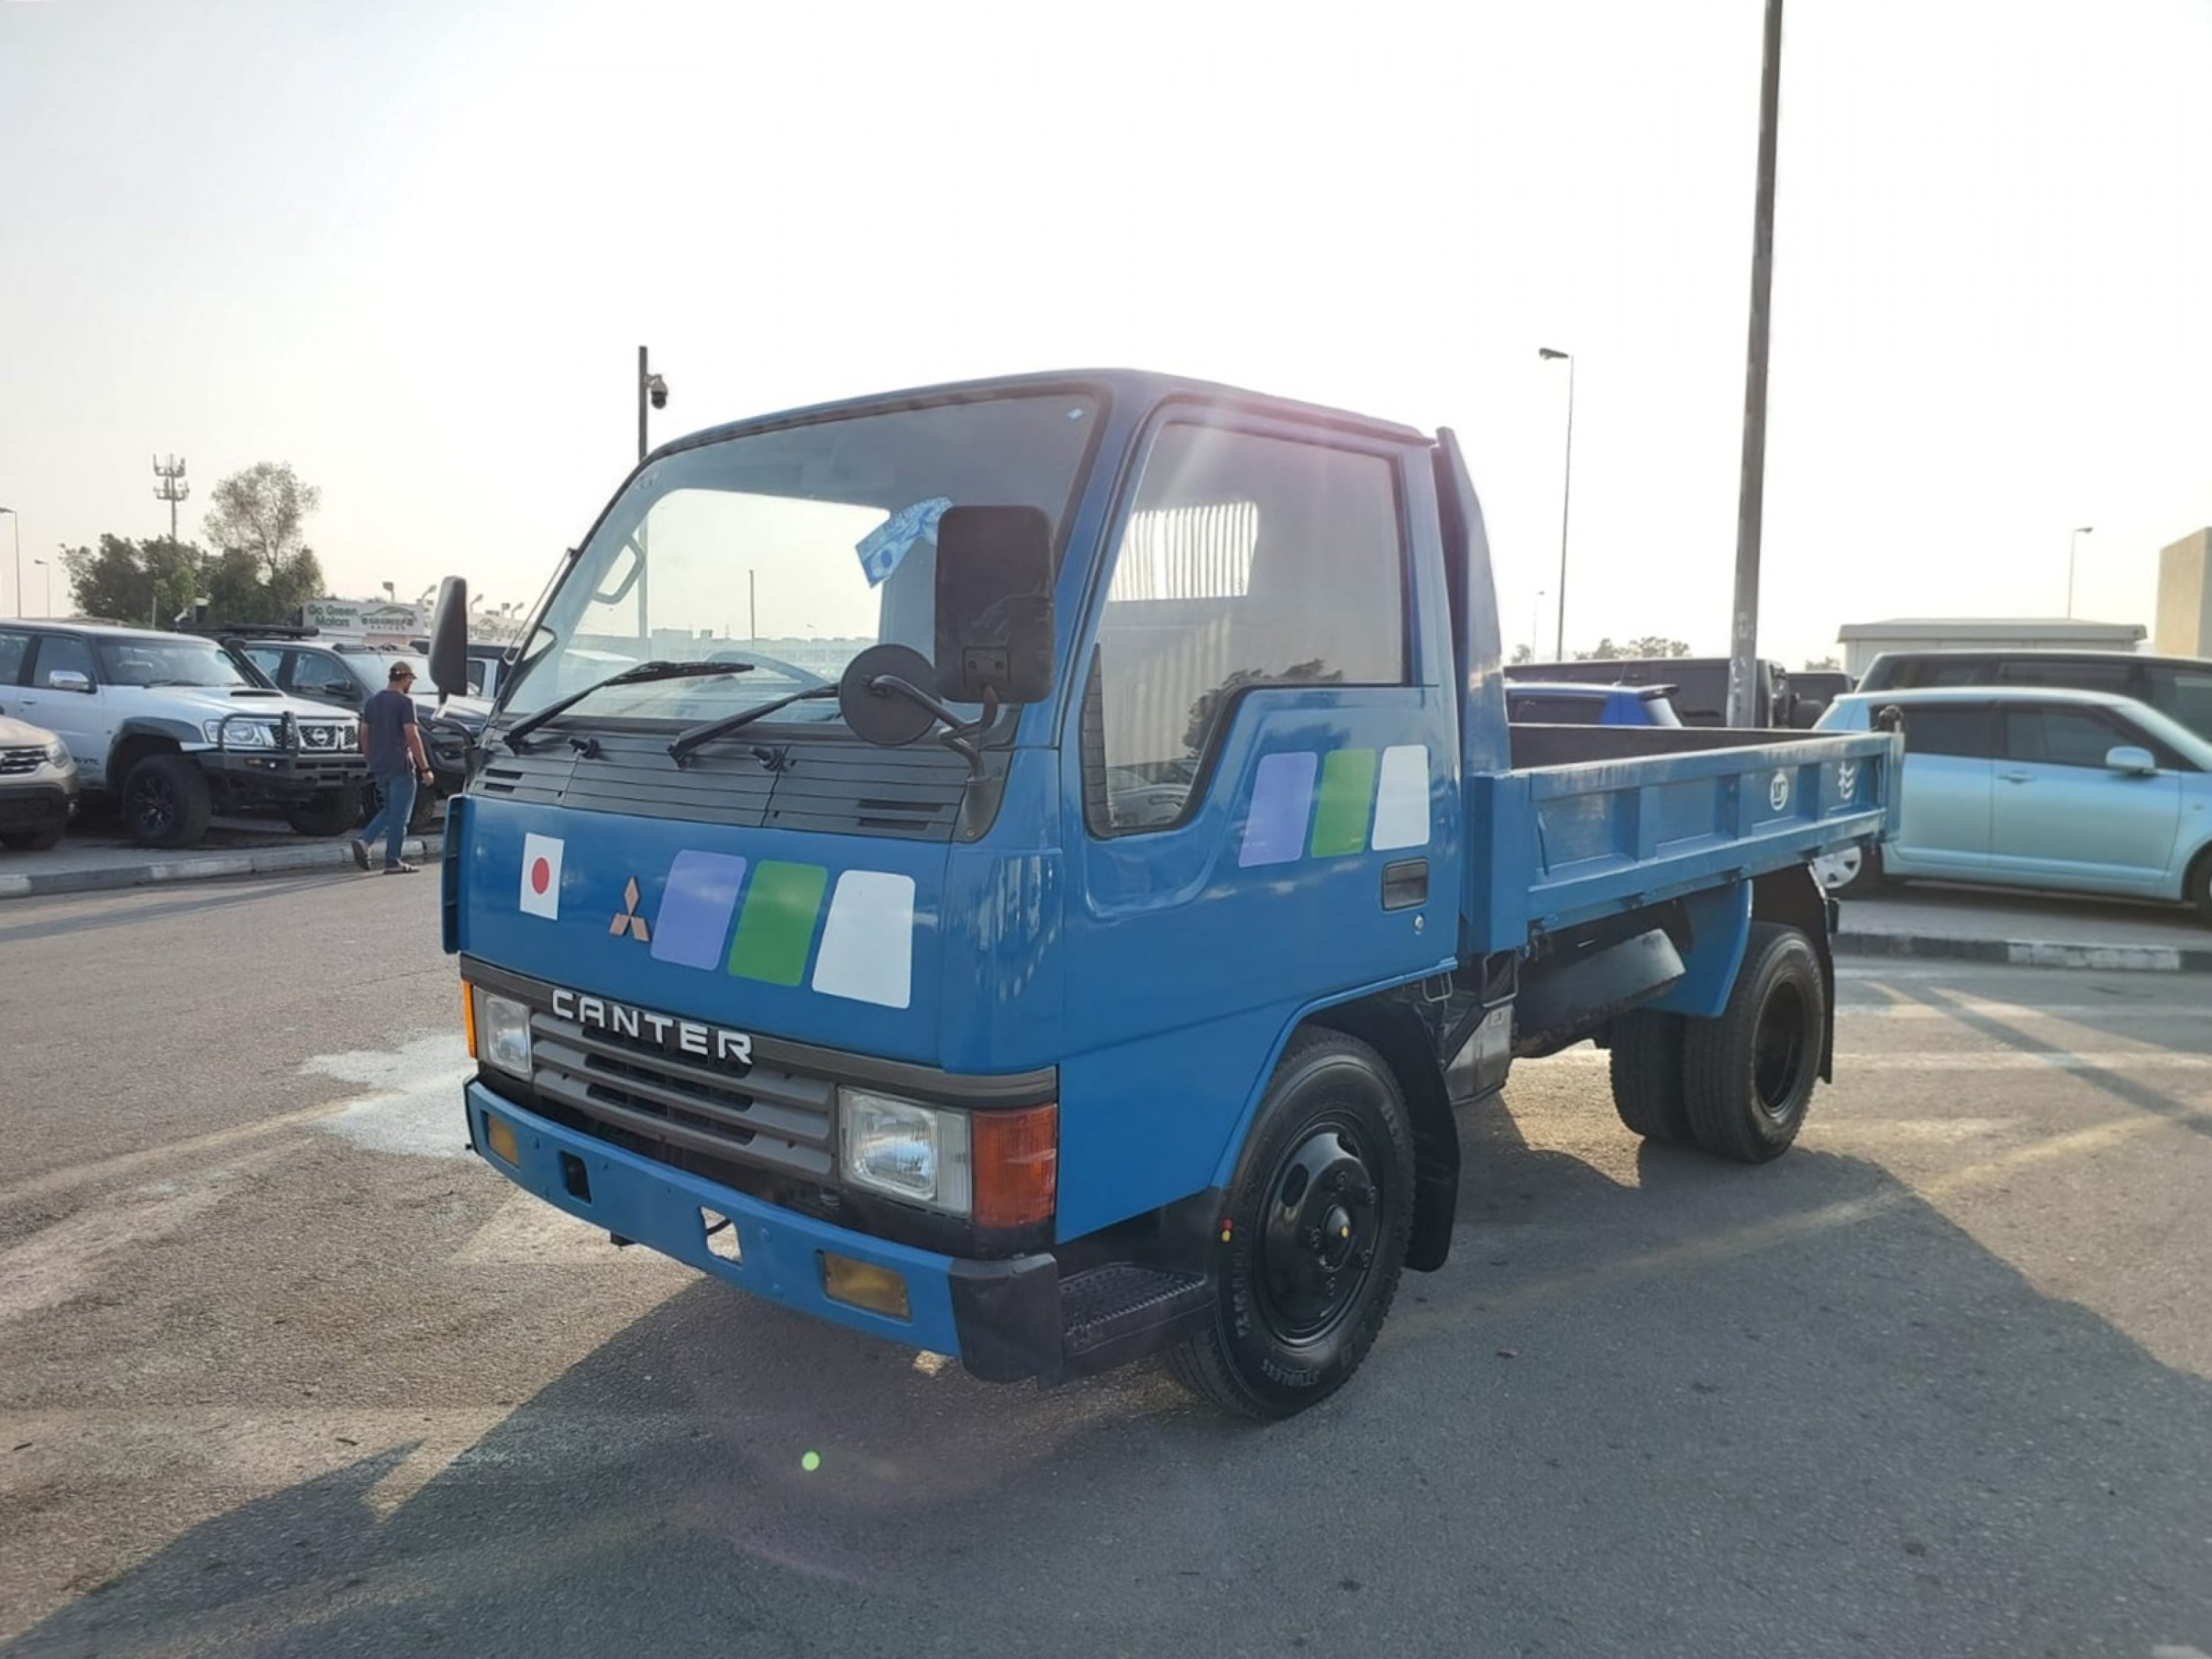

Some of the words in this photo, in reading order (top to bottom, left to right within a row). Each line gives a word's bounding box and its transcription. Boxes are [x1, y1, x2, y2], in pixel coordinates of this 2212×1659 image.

[308, 605, 323, 615] Go
[326, 605, 358, 616] Green
[315, 616, 349, 627] Motors
[553, 989, 753, 1065] CANTER
